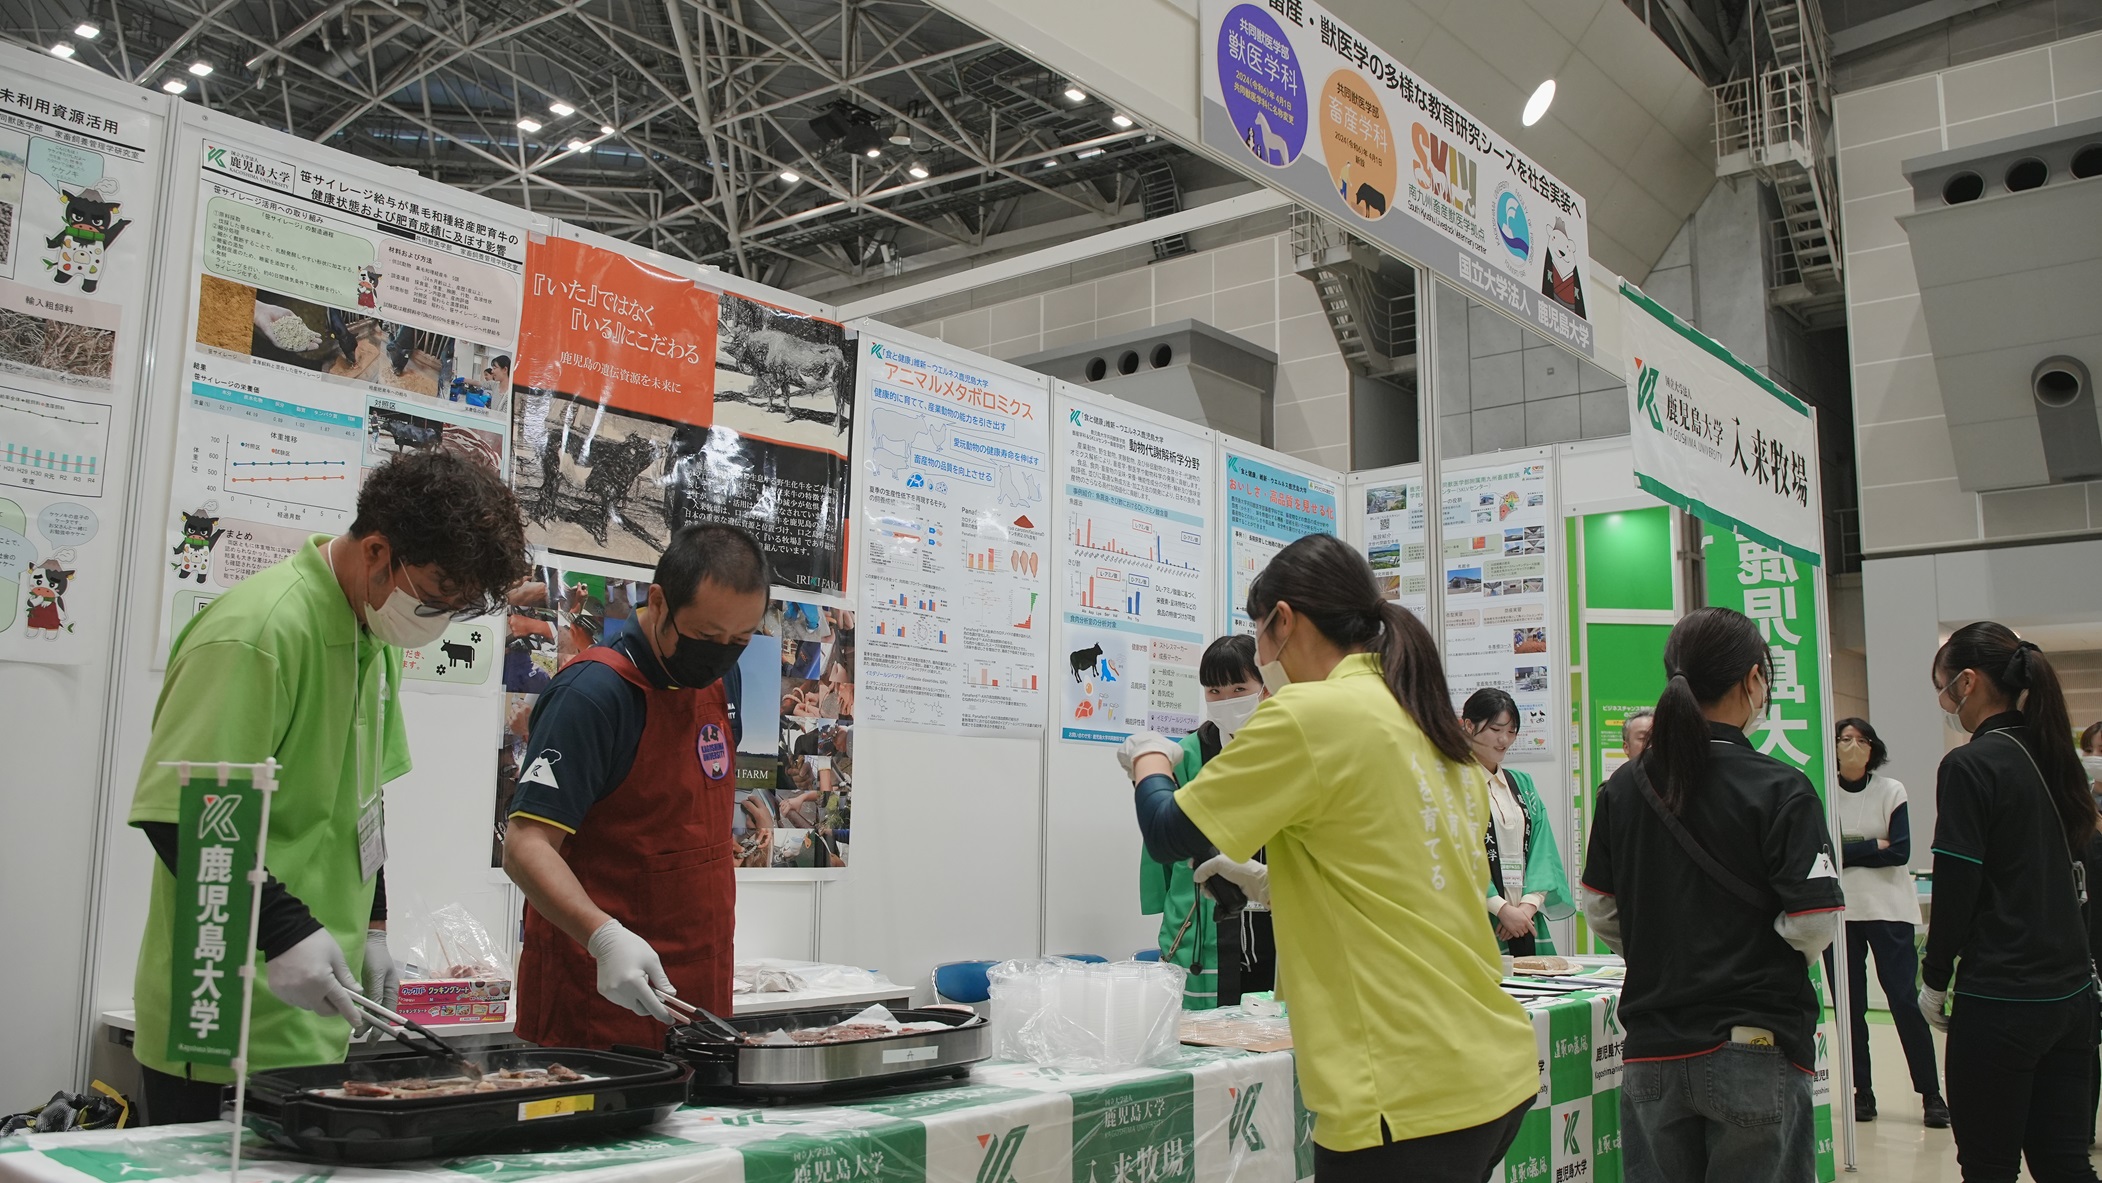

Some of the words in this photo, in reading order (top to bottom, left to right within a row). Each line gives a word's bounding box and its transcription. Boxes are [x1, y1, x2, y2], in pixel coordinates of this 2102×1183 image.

[1240, 17, 1289, 60] 共同獣医学部
[1228, 29, 1298, 97] 獣医学科
[0, 88, 118, 134] 未利用資源活用
[1337, 82, 1380, 119] 共同獣医学部
[1328, 94, 1388, 153] 畜産学科
[230, 156, 291, 183] 鹿児島大学
[213, 184, 324, 224] 笹サイレージ活用への取り組み
[300, 170, 519, 246] 笹サイレージ給与が黒毛和種経産肥育牛の
[311, 188, 507, 257] 健康状態および肥育成績に及ぼす影響
[388, 246, 433, 265] 材料および方法
[533, 273, 655, 326] 『いた』ではなく
[1459, 251, 1531, 317] 国立大学法人
[1537, 300, 1590, 348] 鹿児島大学
[571, 307, 700, 365] 『いる』にこだわる
[193, 361, 207, 372] 結果
[560, 351, 682, 394] 鹿児島の遺伝資源を未来に
[194, 373, 260, 394] 笹サイレージの栄養価
[884, 362, 1034, 421] アニマルメタボロミクス
[374, 399, 396, 411] 対照区
[873, 387, 1007, 432] 健康的に育てて、産業動物の能力を引き出す
[1666, 393, 1724, 447] 鹿児島大学
[210, 436, 220, 444] 700
[270, 432, 298, 444] 体重推移
[953, 437, 1040, 466] 愛玩動物の健康寿命を伸ばす
[1128, 438, 1200, 471] 動物代謝解析学分野
[913, 453, 993, 482] 畜産物の品質を向上させる
[1730, 416, 1808, 508] 入来牧場
[1229, 478, 1335, 520] おいしさ・高品質を見せる化
[226, 529, 253, 541] まとめ
[223, 574, 249, 582] 能である
[701, 743, 724, 753] KAGOSHIMA
[702, 751, 725, 762] UNIVERSITY
[742, 769, 769, 780] FARM
[188, 843, 235, 1040] 鹿児島大学
[428, 984, 469, 995] クッキングシート
[1104, 1098, 1166, 1129] 鹿児島大学
[793, 1151, 885, 1183] 鹿児島大学
[1556, 1158, 1588, 1183] 鹿児島大学
